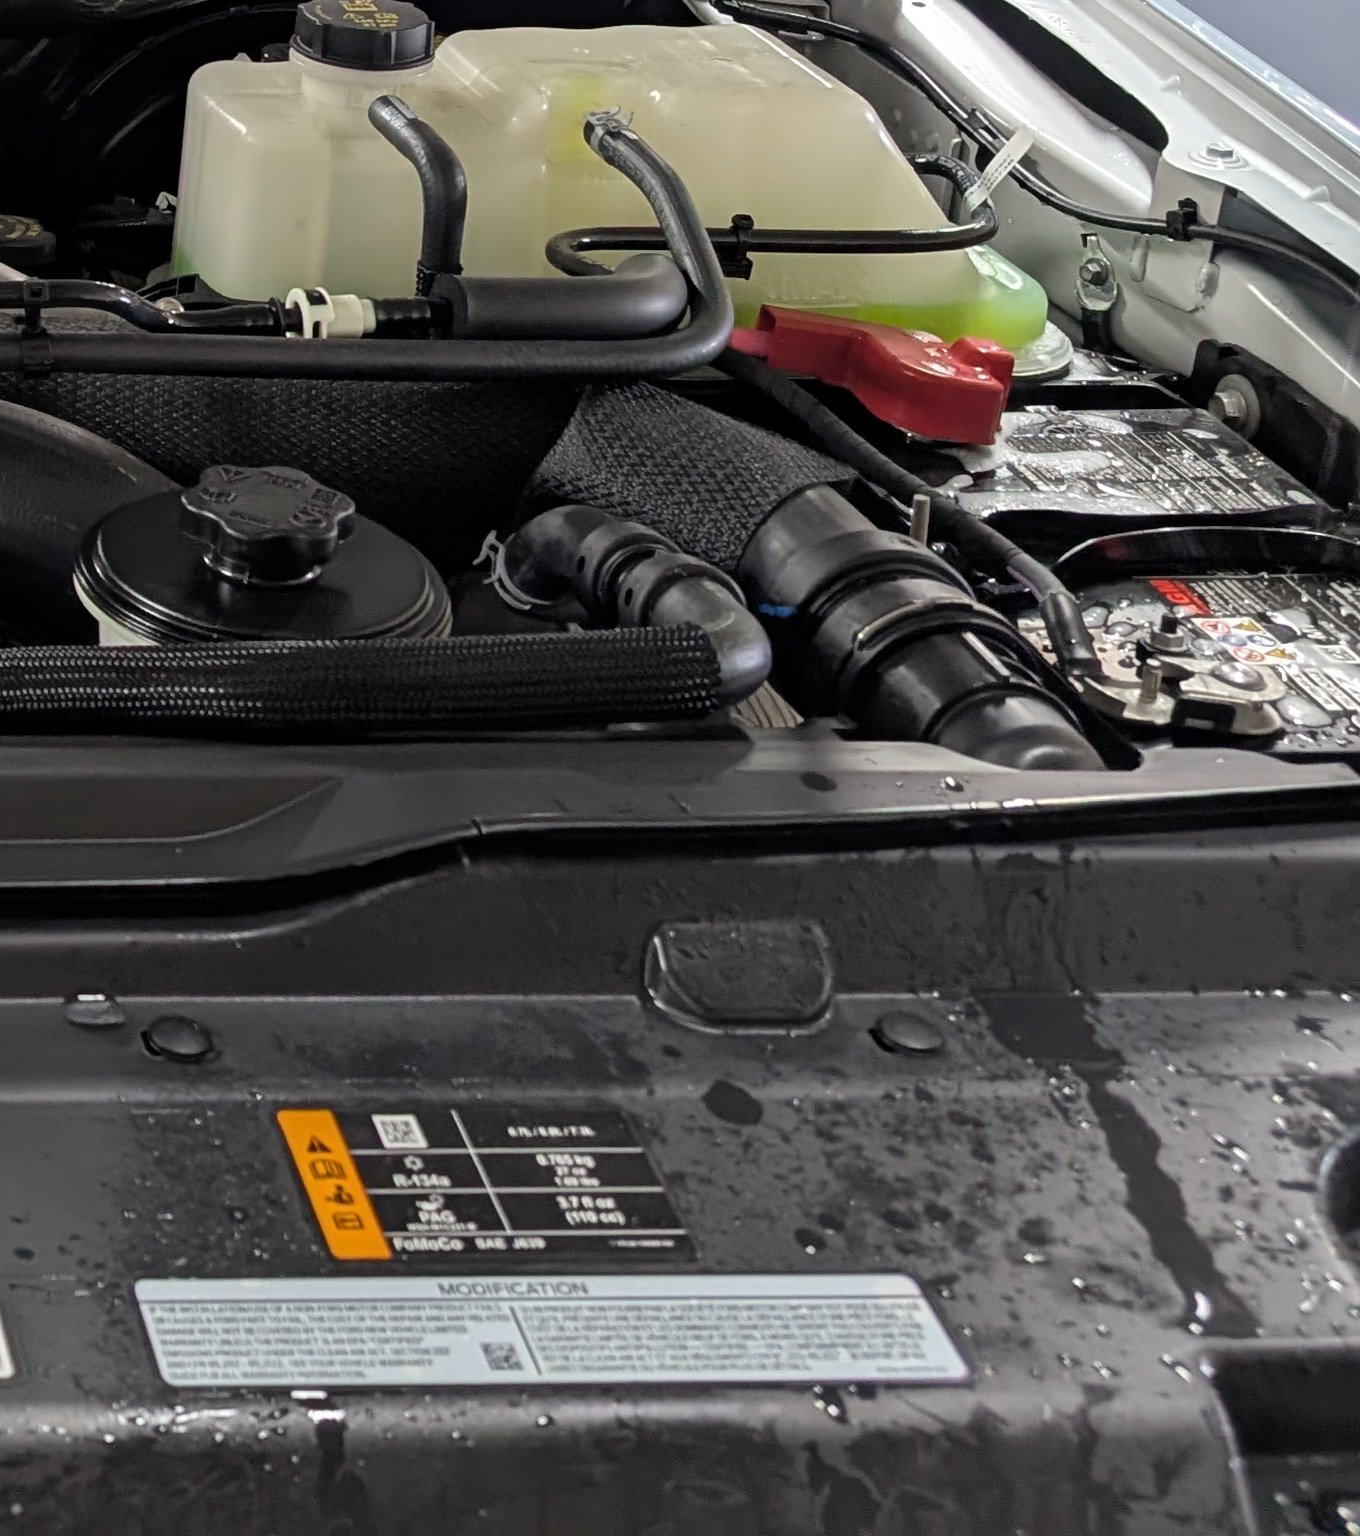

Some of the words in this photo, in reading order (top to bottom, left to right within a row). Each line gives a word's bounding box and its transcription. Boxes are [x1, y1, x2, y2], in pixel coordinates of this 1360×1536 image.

[392, 1173, 452, 1188] R-134a
[418, 1209, 457, 1224] PAG
[392, 1236, 466, 1252] FoMoCo
[474, 1236, 508, 1251] SAE
[437, 1280, 590, 1297] MODIFICATION
